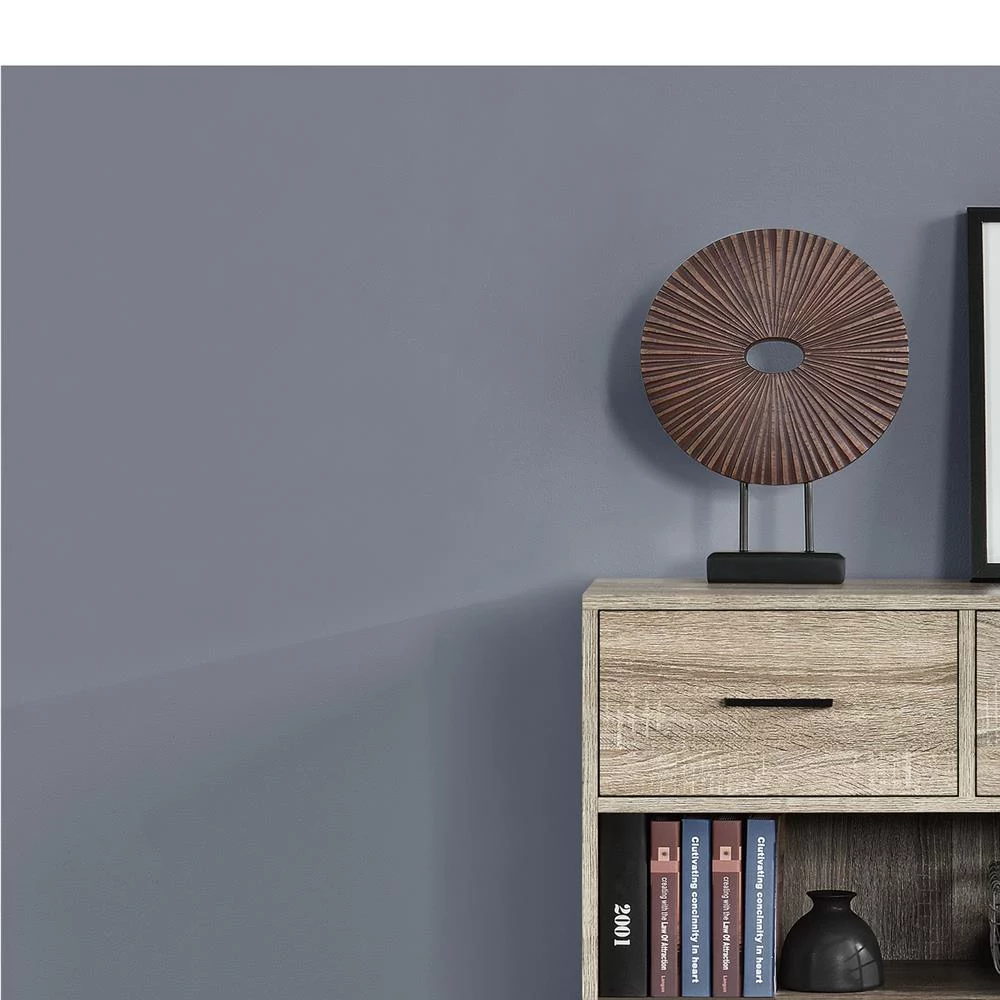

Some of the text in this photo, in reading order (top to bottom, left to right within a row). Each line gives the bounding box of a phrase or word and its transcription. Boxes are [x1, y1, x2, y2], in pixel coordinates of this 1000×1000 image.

[659, 877, 669, 899] creating
[721, 876, 731, 898] creating
[660, 900, 669, 912] with
[722, 900, 730, 911] with
[660, 912, 669, 921] the
[690, 892, 699, 942] concinnity
[722, 912, 730, 920] the
[755, 892, 765, 942] concinnity
[614, 904, 631, 946] 2001
[660, 921, 669, 933] Law
[722, 921, 730, 933] Law
[660, 934, 669, 942] Of
[660, 942, 669, 971] Attraction
[691, 945, 699, 954] in
[722, 942, 730, 970] Attraction
[756, 945, 764, 954] in
[691, 956, 699, 983] heart
[755, 957, 764, 984] heart
